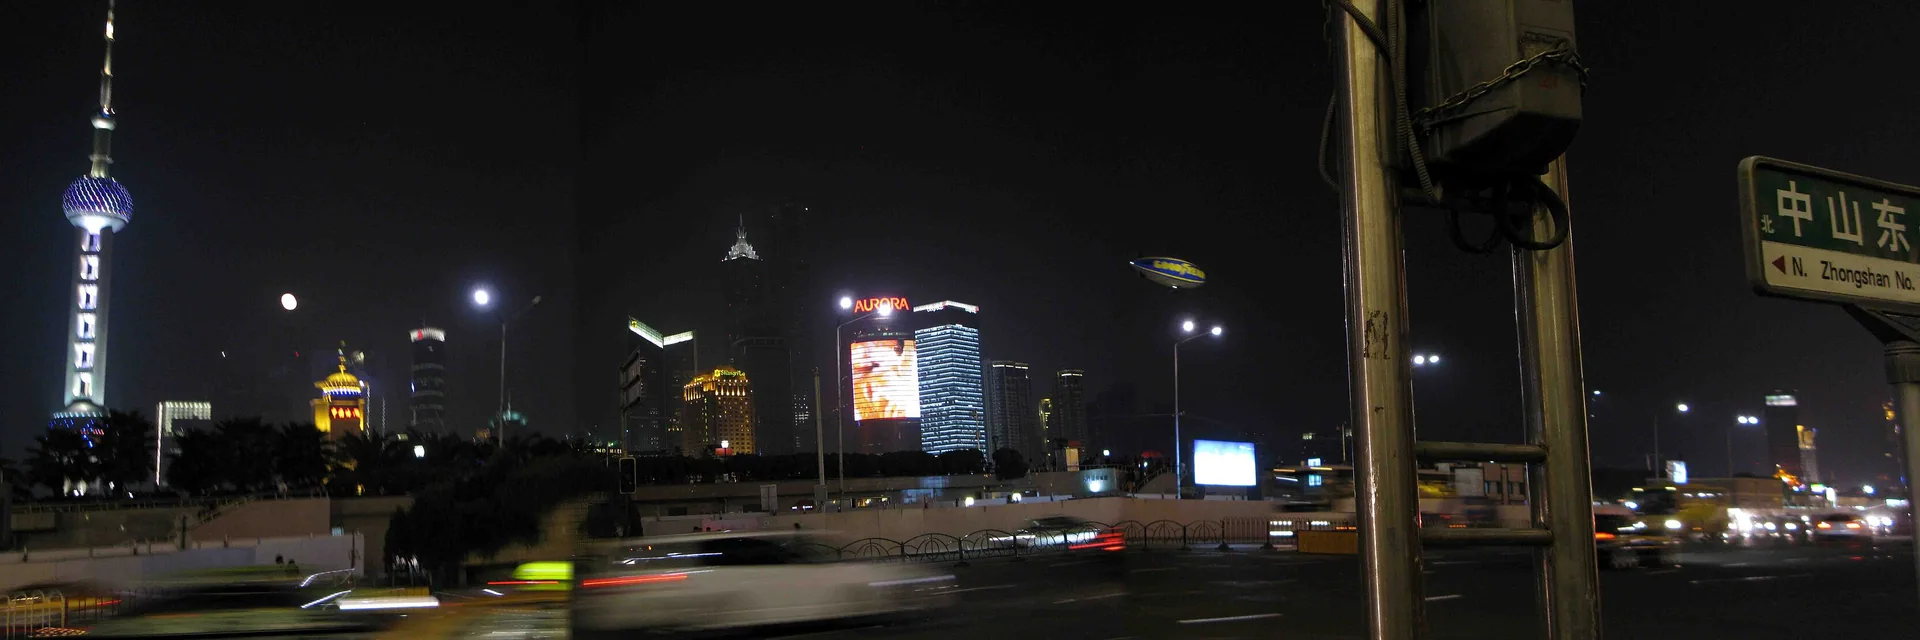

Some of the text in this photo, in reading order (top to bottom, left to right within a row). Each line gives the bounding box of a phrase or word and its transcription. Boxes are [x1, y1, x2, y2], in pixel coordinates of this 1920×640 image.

[1792, 256, 1916, 291] N. Zhongshan No.
[854, 297, 910, 313] AURORA
